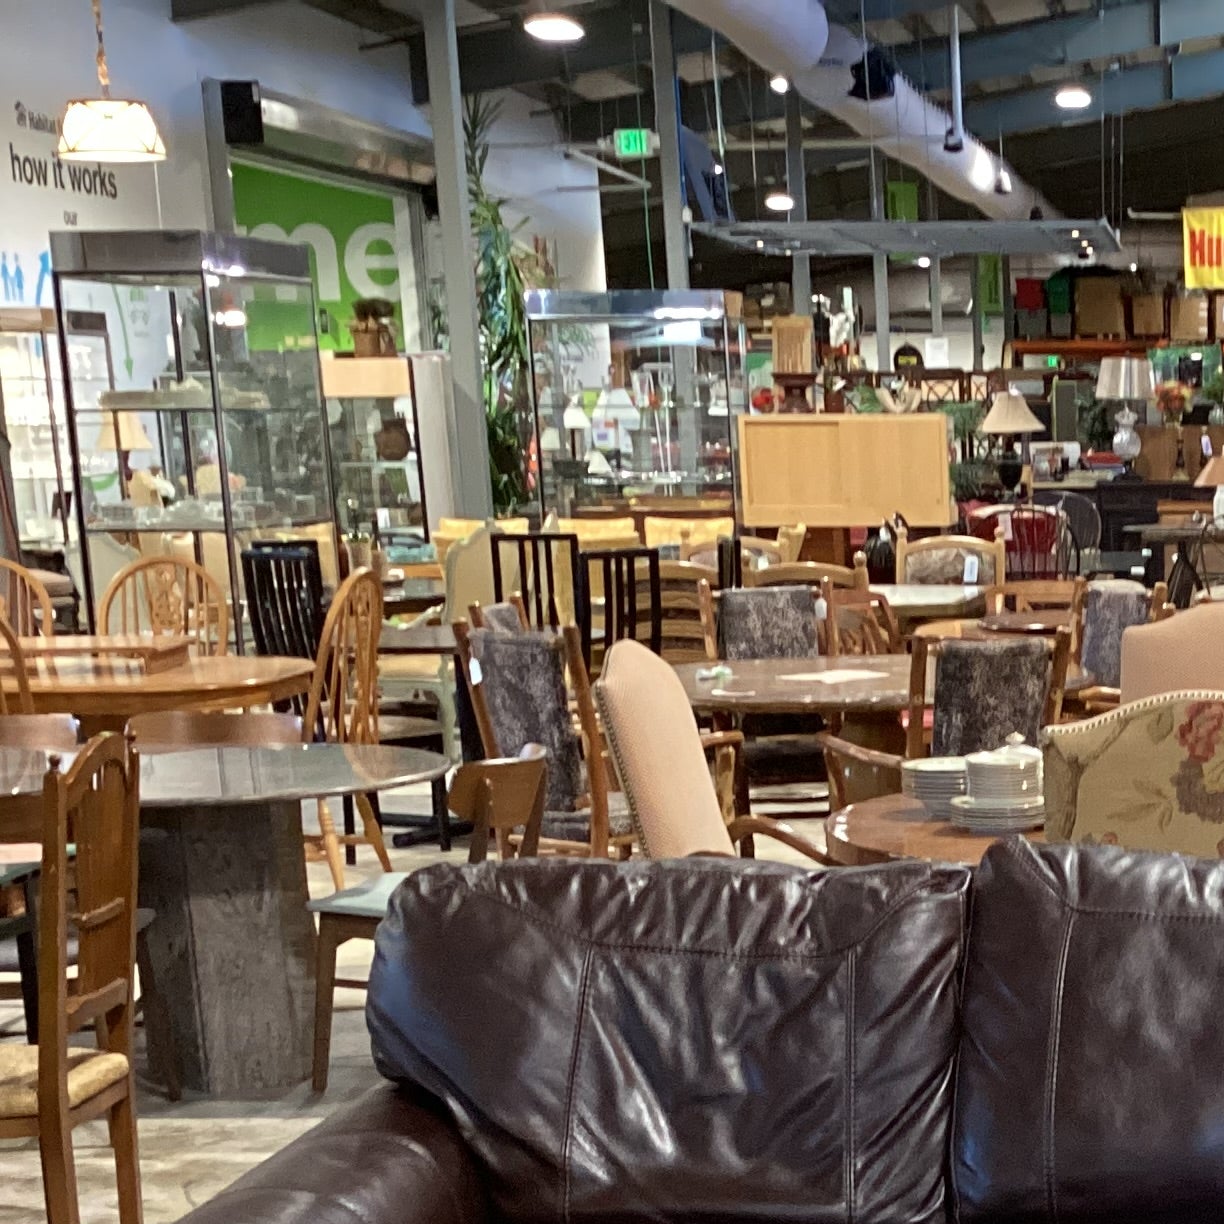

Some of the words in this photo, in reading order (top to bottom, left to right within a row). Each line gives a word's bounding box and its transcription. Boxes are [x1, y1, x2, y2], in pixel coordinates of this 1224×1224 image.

[9, 142, 48, 186] how
[52, 152, 65, 189] it
[68, 162, 118, 199] works
